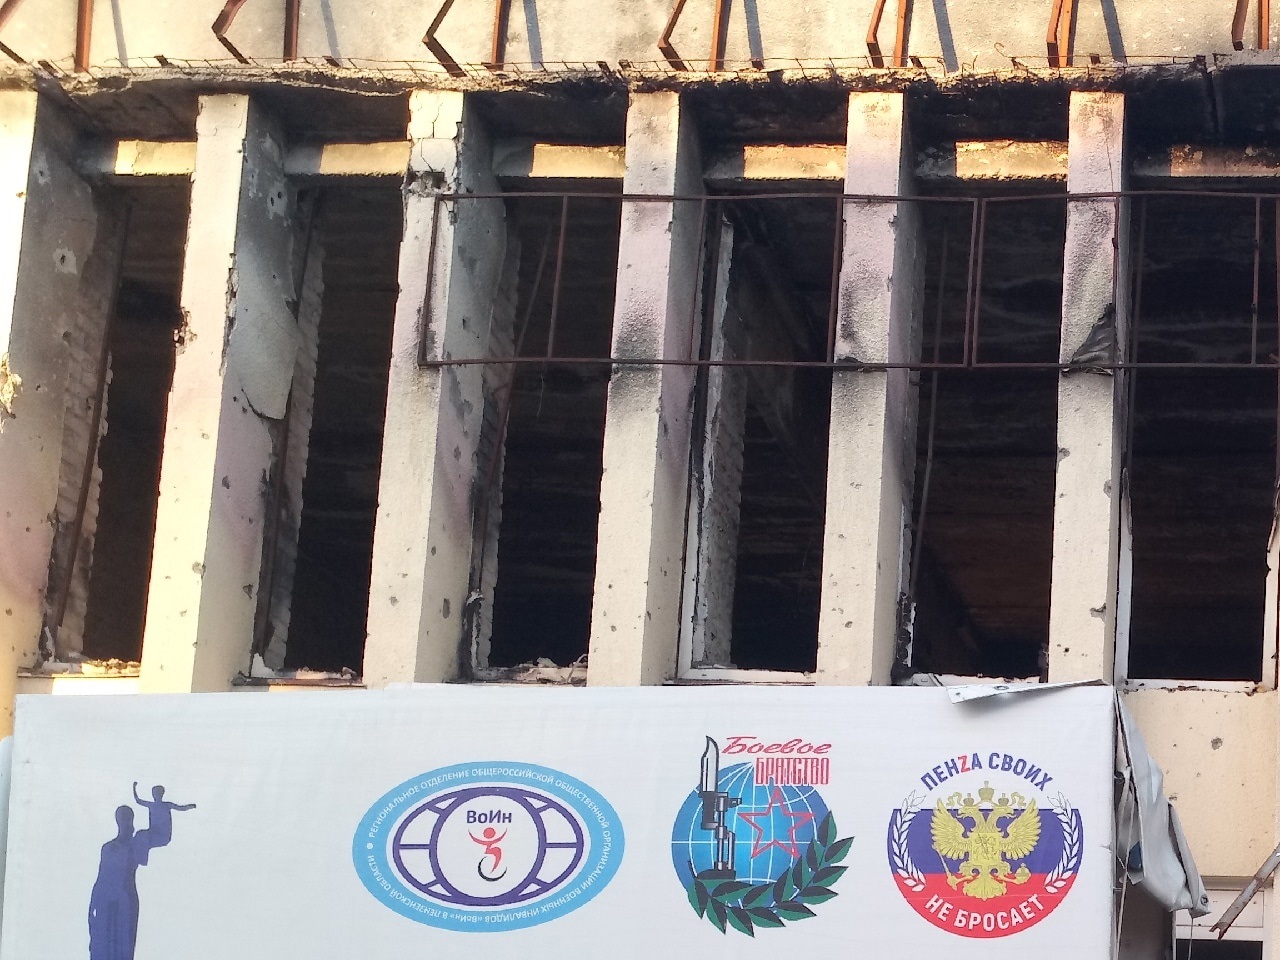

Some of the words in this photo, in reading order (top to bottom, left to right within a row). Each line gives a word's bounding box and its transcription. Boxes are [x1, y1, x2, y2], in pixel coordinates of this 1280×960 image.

[722, 736, 832, 755] Боевое
[420, 770, 470, 790] ОТДЕЛЕНИЕ
[471, 767, 554, 785] ОБЩЕРОССИЙСКОЙ
[755, 756, 830, 786] БРАТСТВО
[988, 752, 1053, 791] СВОИХ
[368, 785, 420, 838] РЕГИОНАЛЬНОЕ
[466, 810, 512, 824] ВоИн
[555, 779, 610, 829] ОБЩЕСТВЕННОЙ
[366, 855, 392, 891] ОБЛАСТИ
[580, 830, 612, 890] ОРГАНИЗАЦИИ
[390, 888, 441, 918] ПЕНЗЕНСКОЙ
[541, 887, 582, 913] ВОЕННЫХ
[924, 893, 954, 922] НЕ
[954, 893, 1046, 932] БРОСАЕТ
[484, 907, 540, 924] ИНВАЛИДОВ
